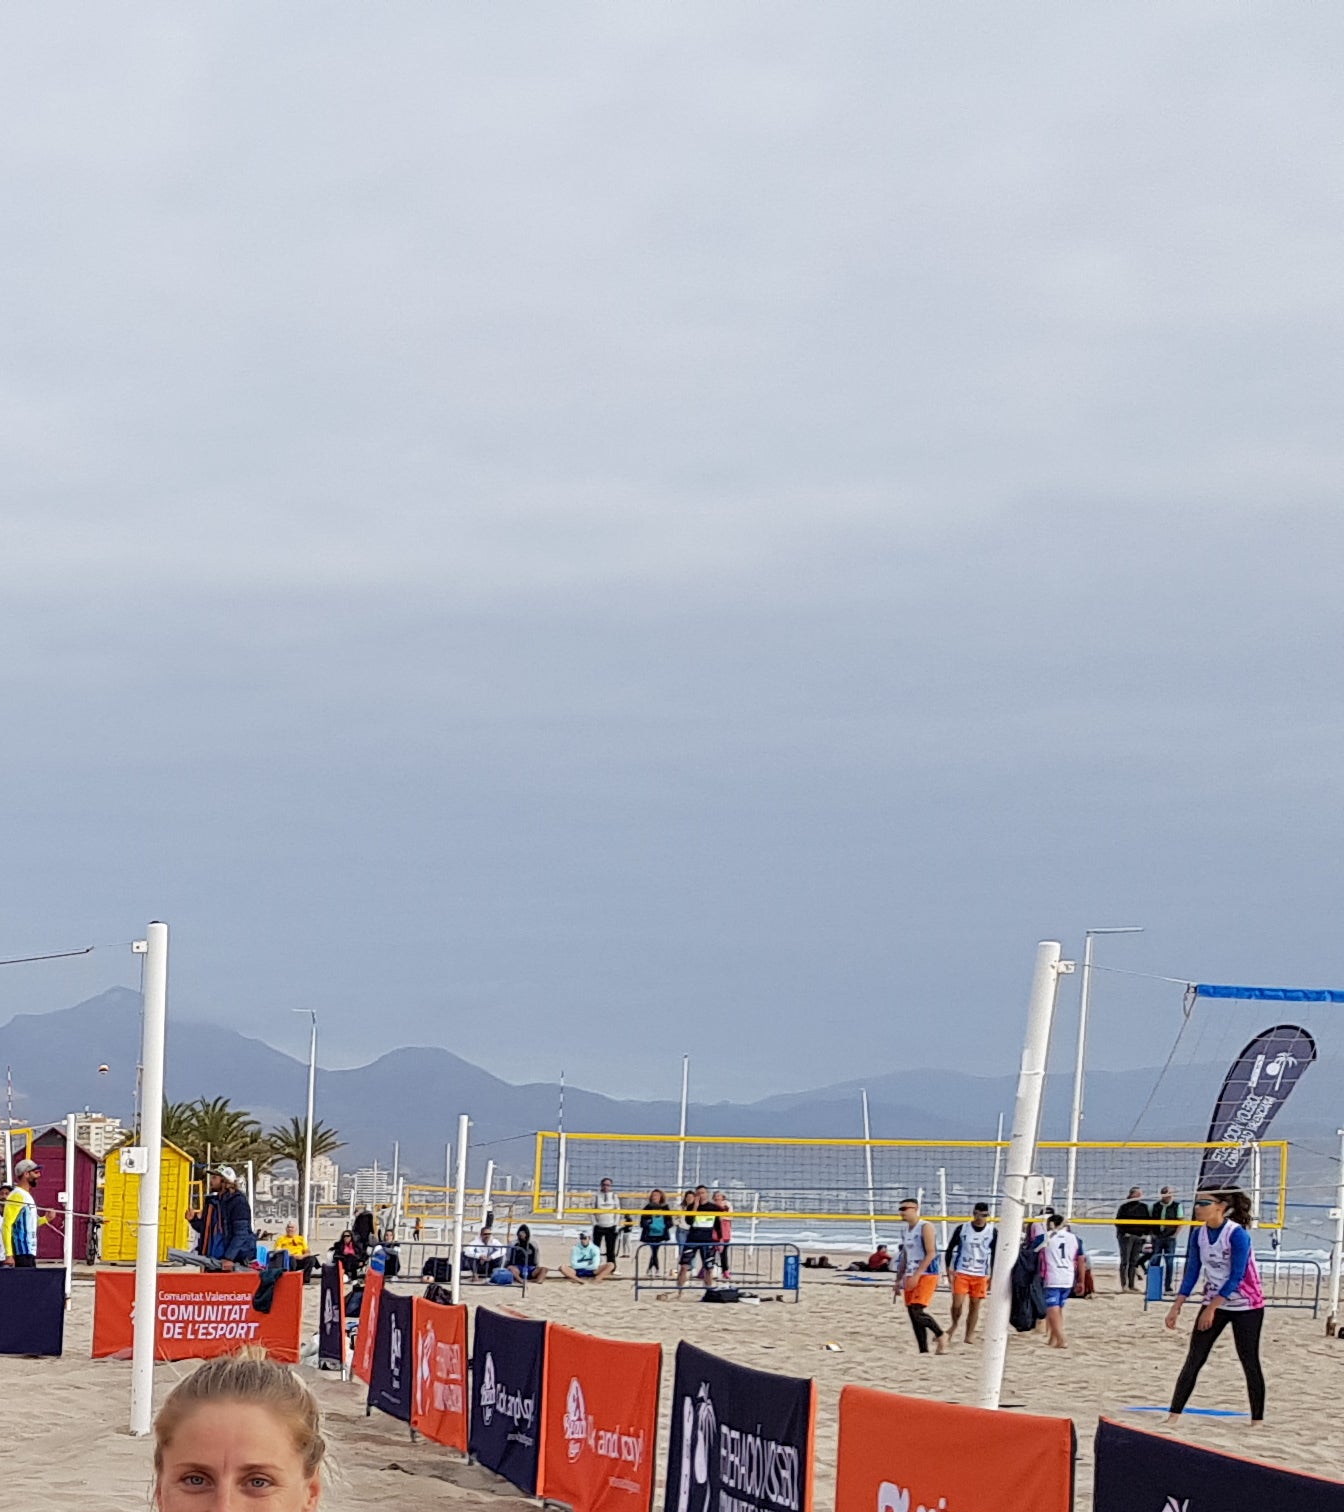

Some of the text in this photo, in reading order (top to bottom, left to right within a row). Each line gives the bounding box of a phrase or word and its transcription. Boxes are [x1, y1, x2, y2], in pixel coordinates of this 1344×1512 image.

[1057, 1243, 1066, 1259] 1
[158, 1290, 252, 1302] Comunitat Valenciana
[157, 1303, 250, 1322] COMUNITAT
[162, 1322, 260, 1340] DE L'ESPORT
